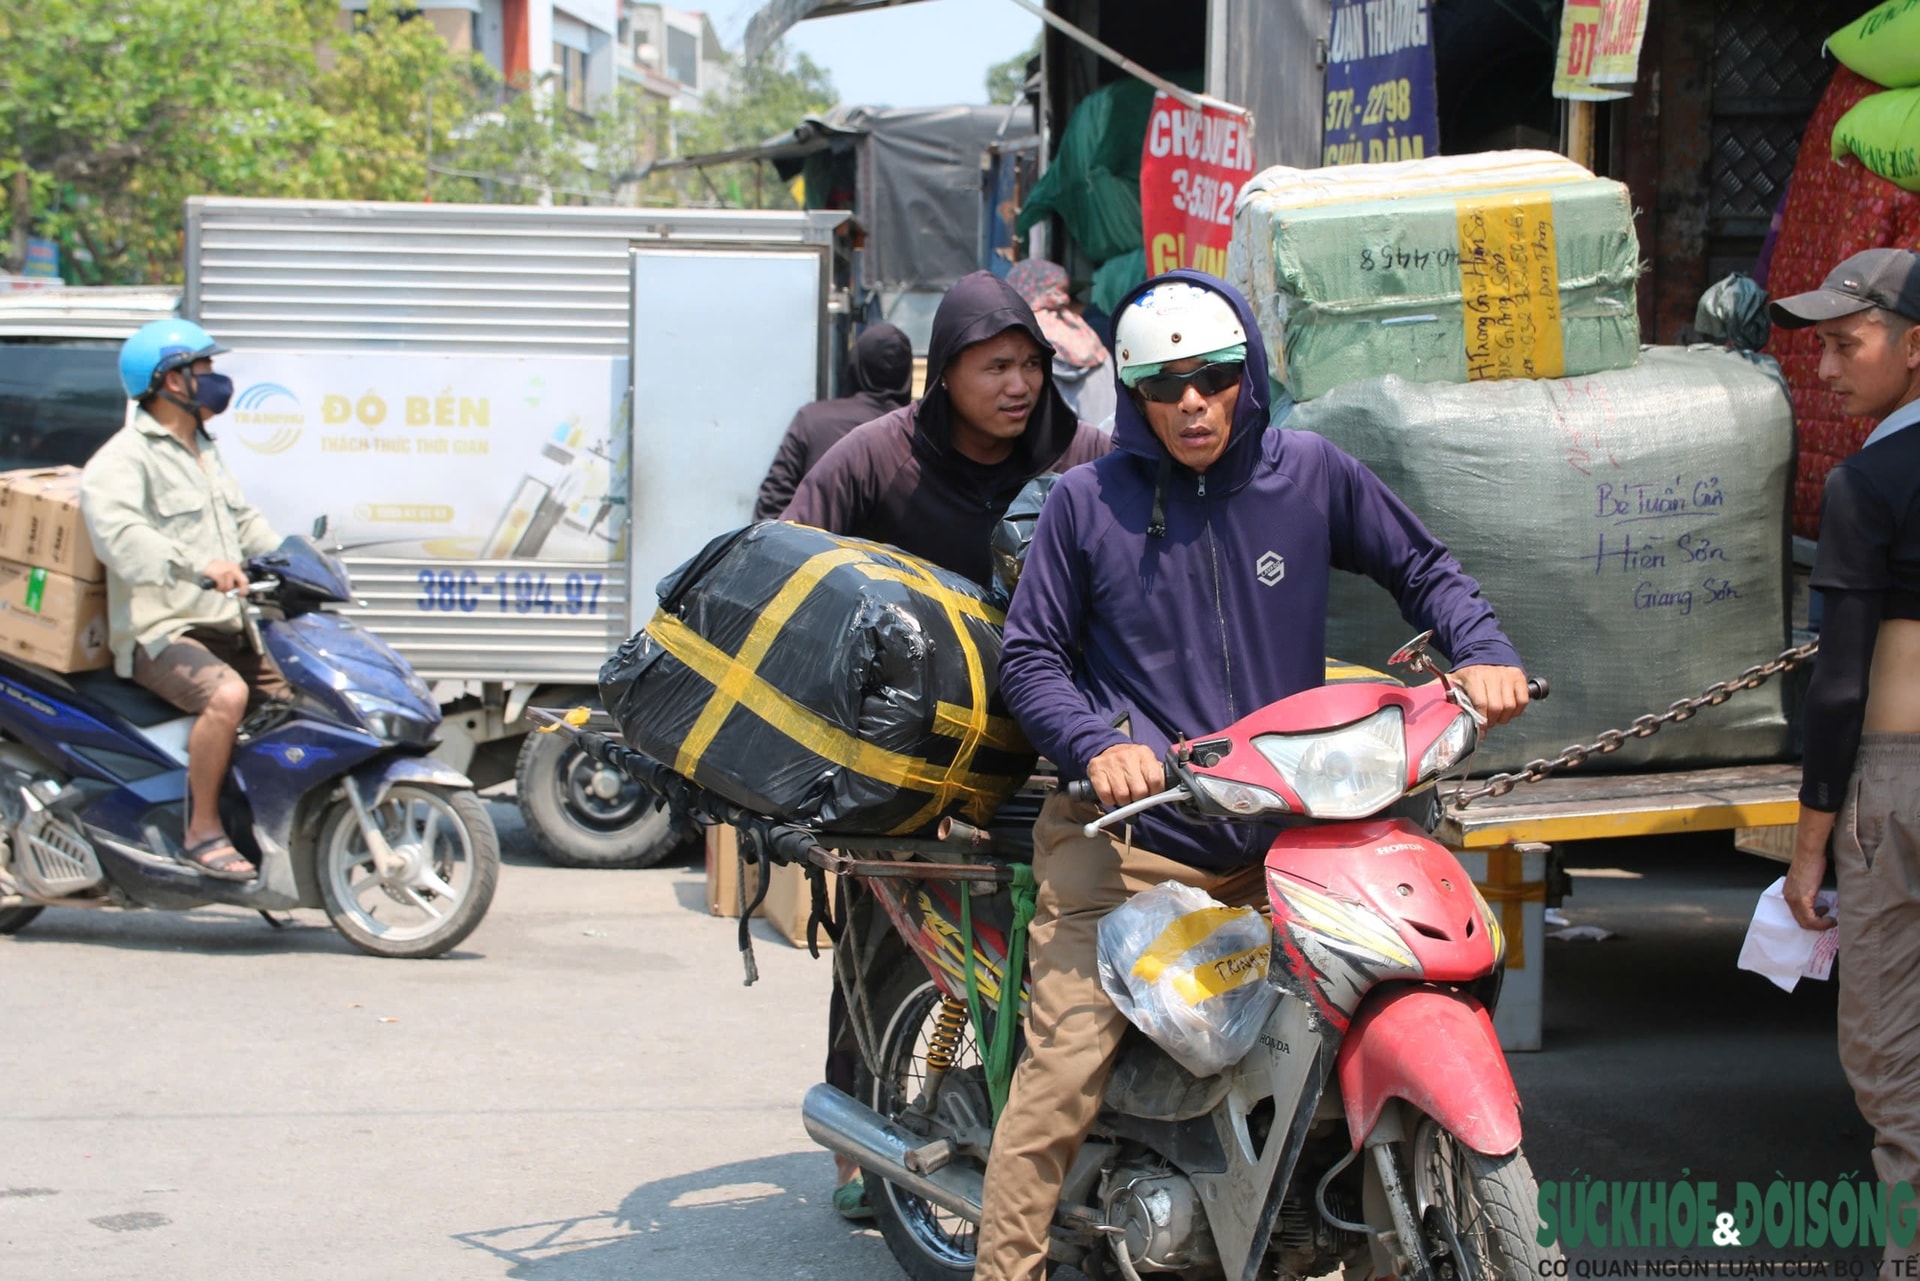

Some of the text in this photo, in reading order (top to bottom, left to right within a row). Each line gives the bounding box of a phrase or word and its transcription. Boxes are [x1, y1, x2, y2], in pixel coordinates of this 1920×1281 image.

[321, 388, 388, 431] ĐỘ
[417, 569, 603, 615] 38C-194.97
[1634, 580, 1693, 616] Giang
[1375, 843, 1425, 855] HONDA
[1258, 1033, 1291, 1055] HONDA
